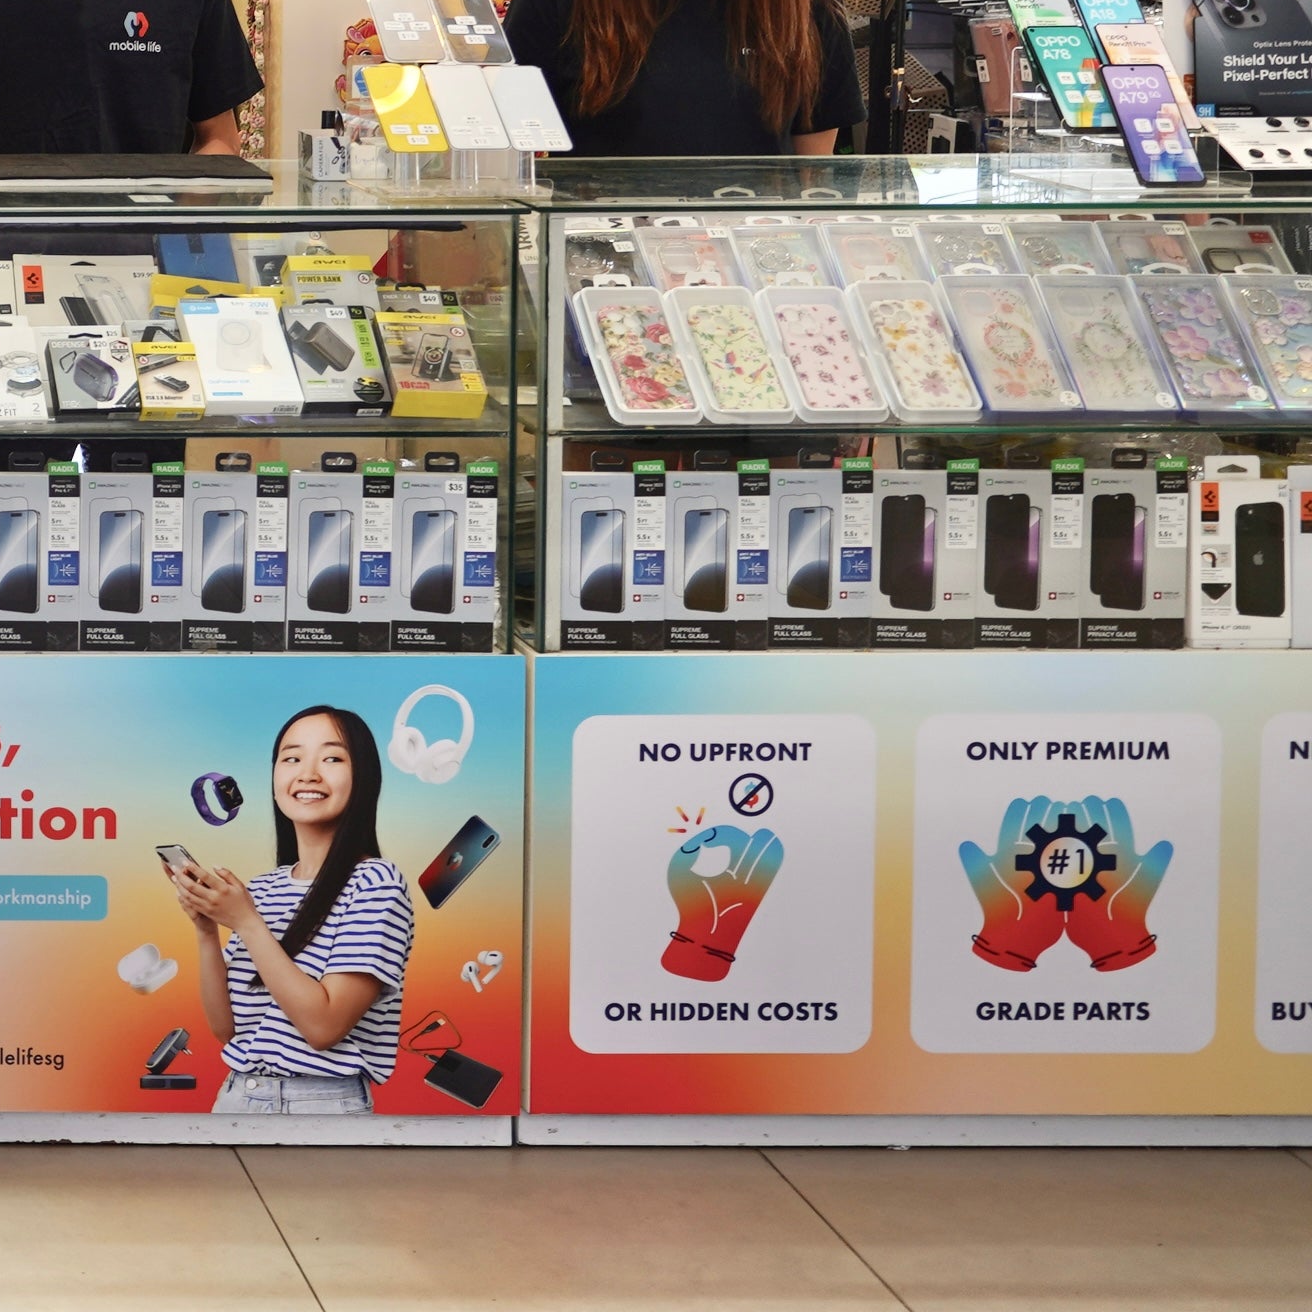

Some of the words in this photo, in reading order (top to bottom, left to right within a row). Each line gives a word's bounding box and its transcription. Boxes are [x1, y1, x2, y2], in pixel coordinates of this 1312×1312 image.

[1090, 9, 1117, 21] A18
[109, 40, 146, 52] mobile
[147, 40, 162, 53] life
[1035, 35, 1081, 48] OPPO
[1042, 49, 1072, 61] A78
[1223, 53, 1265, 67] Shield
[1267, 53, 1298, 66] Your
[1223, 67, 1308, 83] Pixel-Perfect
[1111, 76, 1159, 90] OPPO
[1119, 90, 1148, 104] A79
[1198, 106, 1212, 117] 9H
[637, 464, 662, 473] RADIX
[639, 743, 681, 763] NO
[689, 742, 812, 762] UPFRONT
[966, 741, 1039, 761] ONLY
[1046, 740, 1171, 761] PREMIUM
[1047, 849, 1087, 876] #1
[604, 1002, 643, 1022] OR
[650, 1002, 751, 1022] HIDDEN
[756, 1001, 839, 1022] COSTS
[975, 1002, 1066, 1022] GRADE
[1072, 1002, 1151, 1022] PARTS
